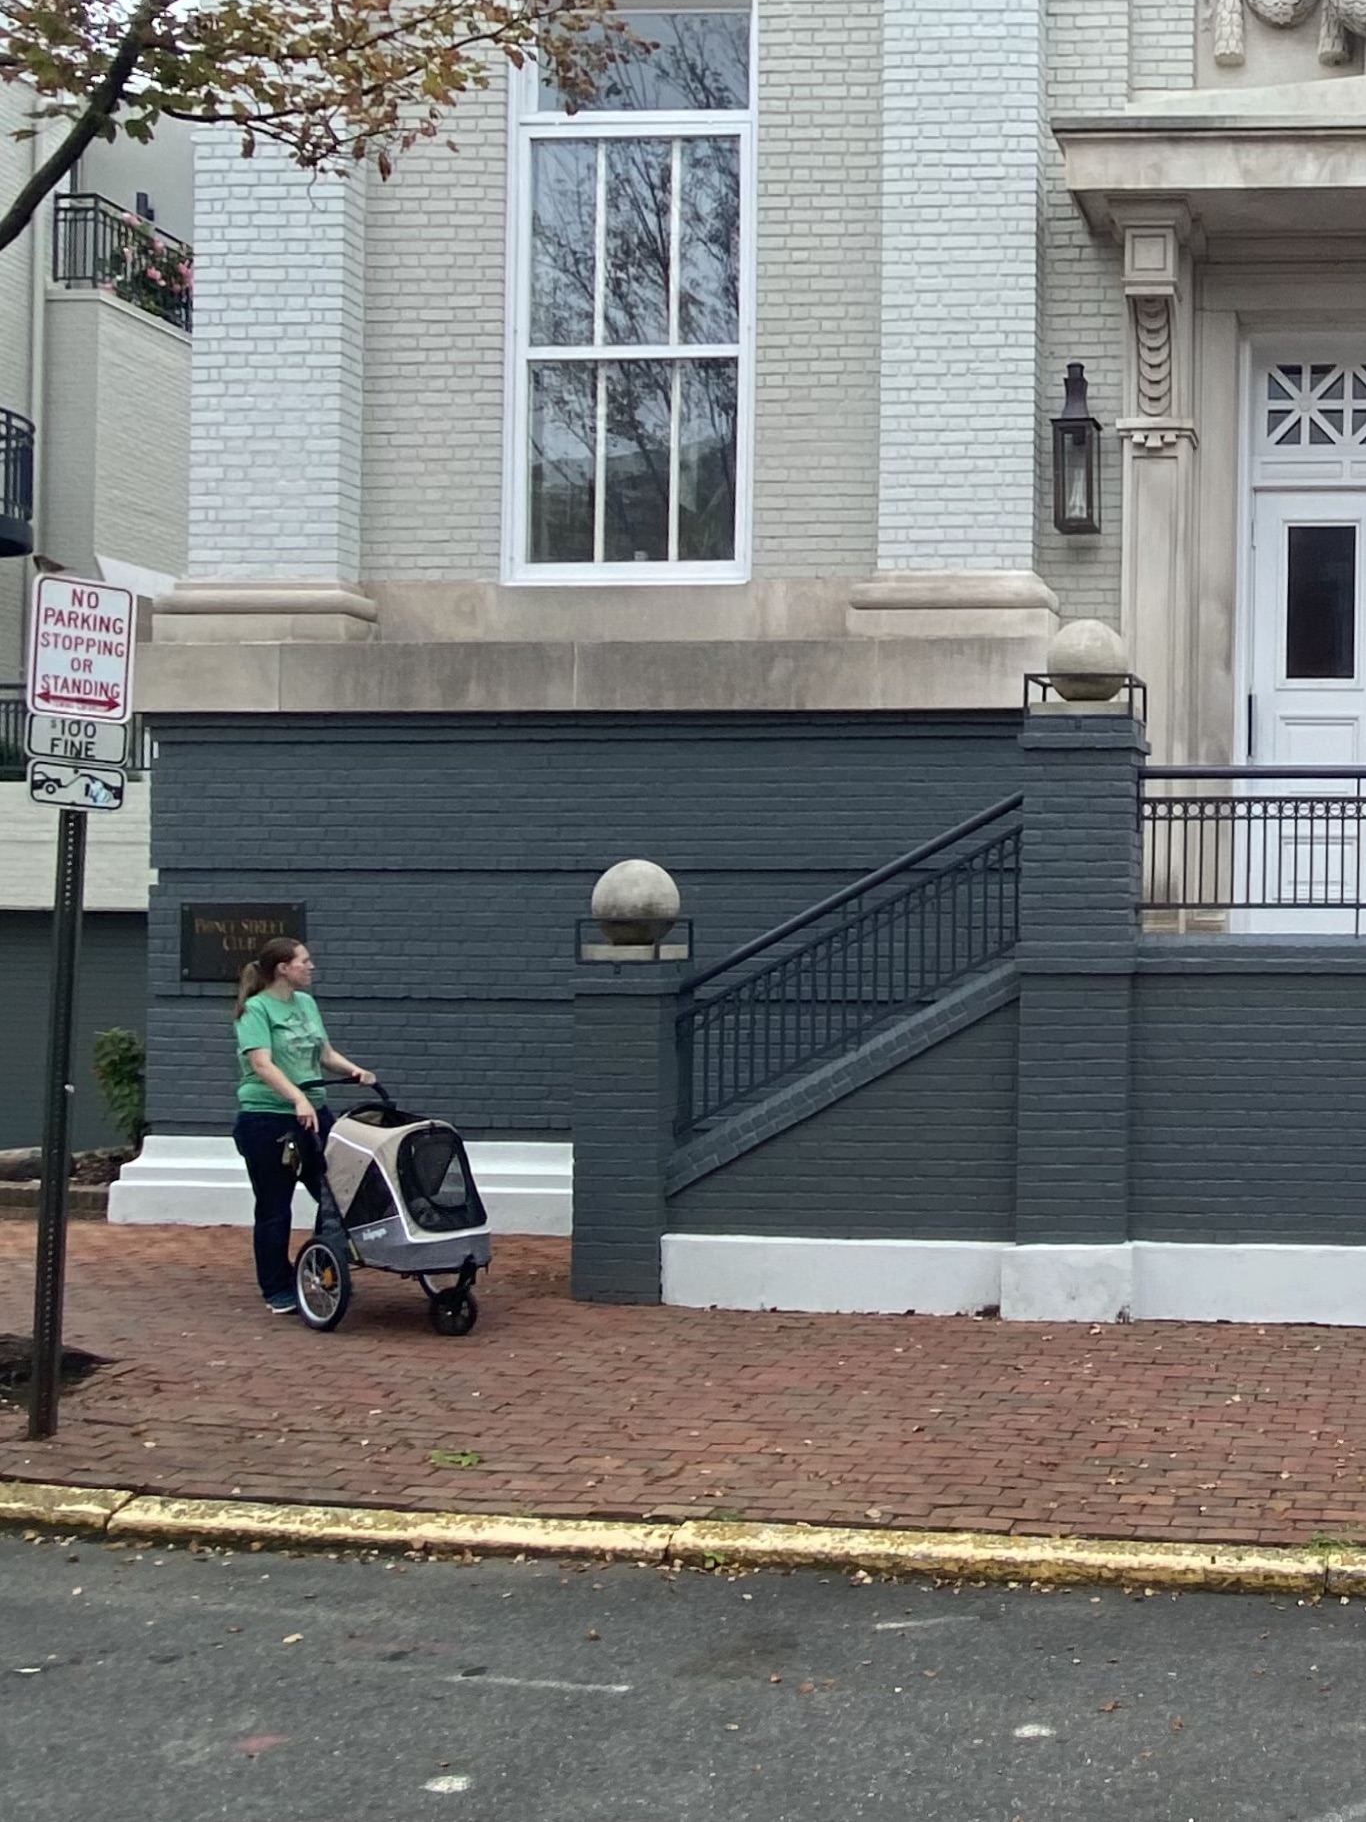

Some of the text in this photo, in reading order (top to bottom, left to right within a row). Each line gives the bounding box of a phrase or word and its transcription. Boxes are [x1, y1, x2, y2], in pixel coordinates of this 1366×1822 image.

[71, 589, 99, 609] NO
[44, 607, 124, 635] PARKING
[40, 632, 125, 658] STOPPING
[71, 657, 93, 674] OR
[41, 674, 120, 699] STANDING
[51, 737, 96, 758] FINE
